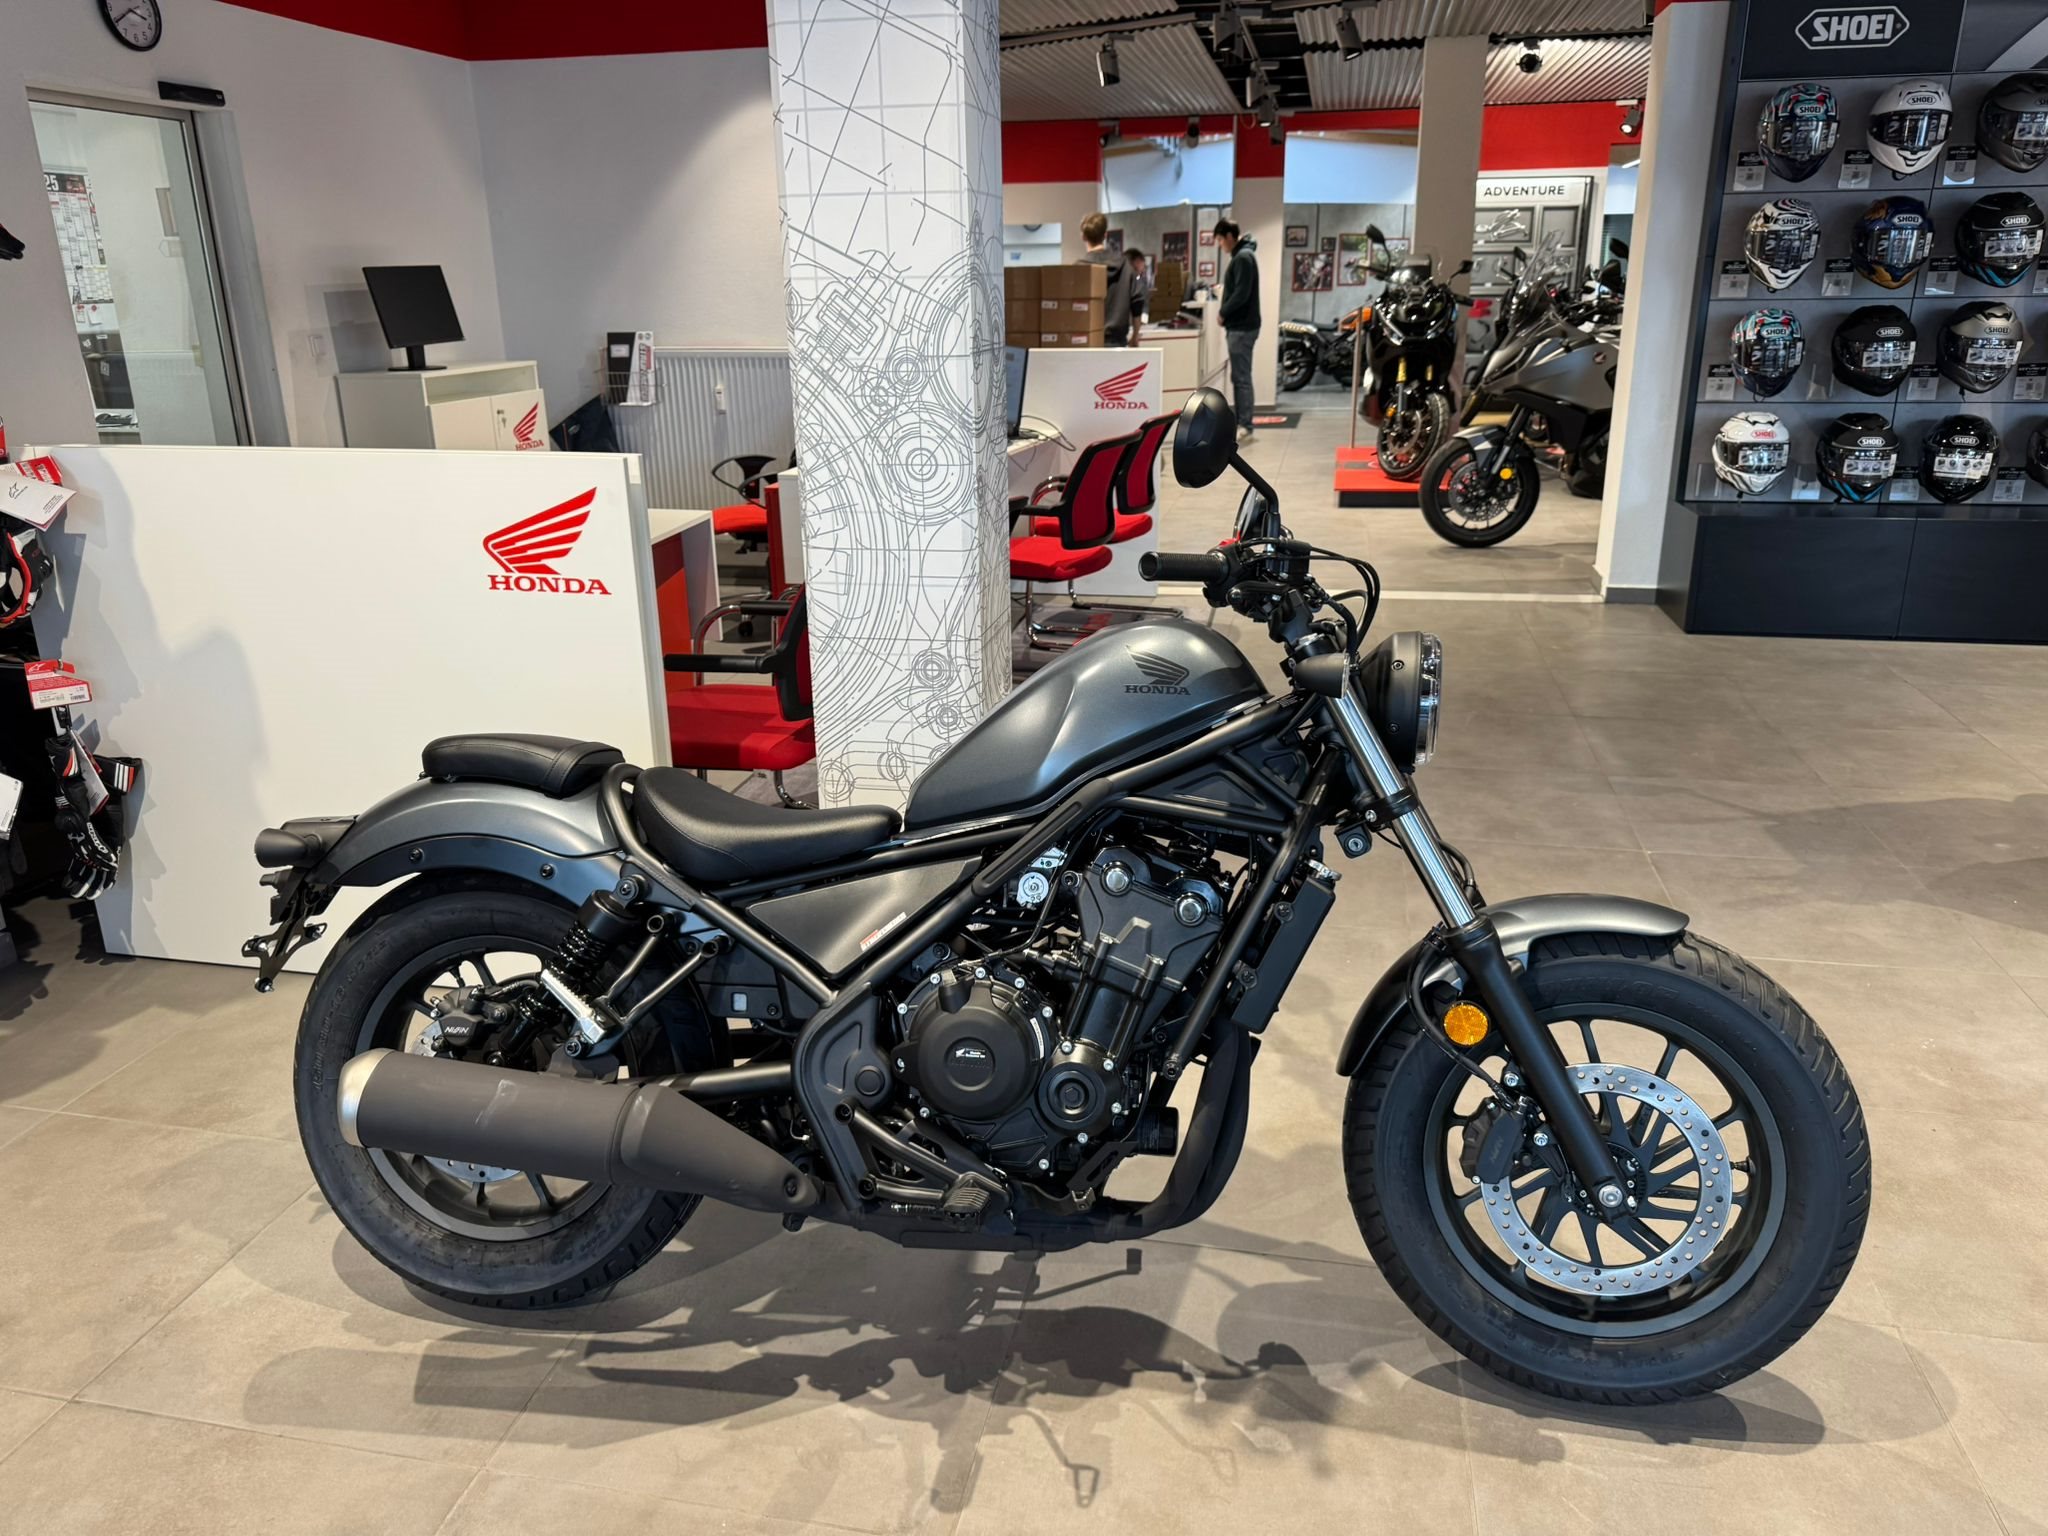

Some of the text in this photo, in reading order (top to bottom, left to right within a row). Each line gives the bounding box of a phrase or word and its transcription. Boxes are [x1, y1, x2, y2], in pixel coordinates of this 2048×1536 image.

[1811, 13, 1895, 42] SHOEI
[1911, 96, 1934, 104] SHOEI
[1799, 106, 1822, 114] SHOEI
[1483, 185, 1566, 197] ADVENTURE
[1781, 217, 1805, 225] SHOEI
[1896, 215, 1920, 223] SHOEI
[2005, 216, 2028, 225] SHOEI
[1765, 328, 1787, 336] SHOEI
[1880, 328, 1901, 336] SHOEI
[1988, 326, 2009, 334] SHOEI
[1094, 401, 1148, 409] HONDA
[1754, 430, 1775, 438] SHOEI
[1861, 438, 1882, 446] SHOEI
[1954, 436, 1977, 444] SHOEI
[515, 439, 544, 451] HONDA
[487, 574, 612, 595] HONDA
[1124, 684, 1192, 696] HONDA
